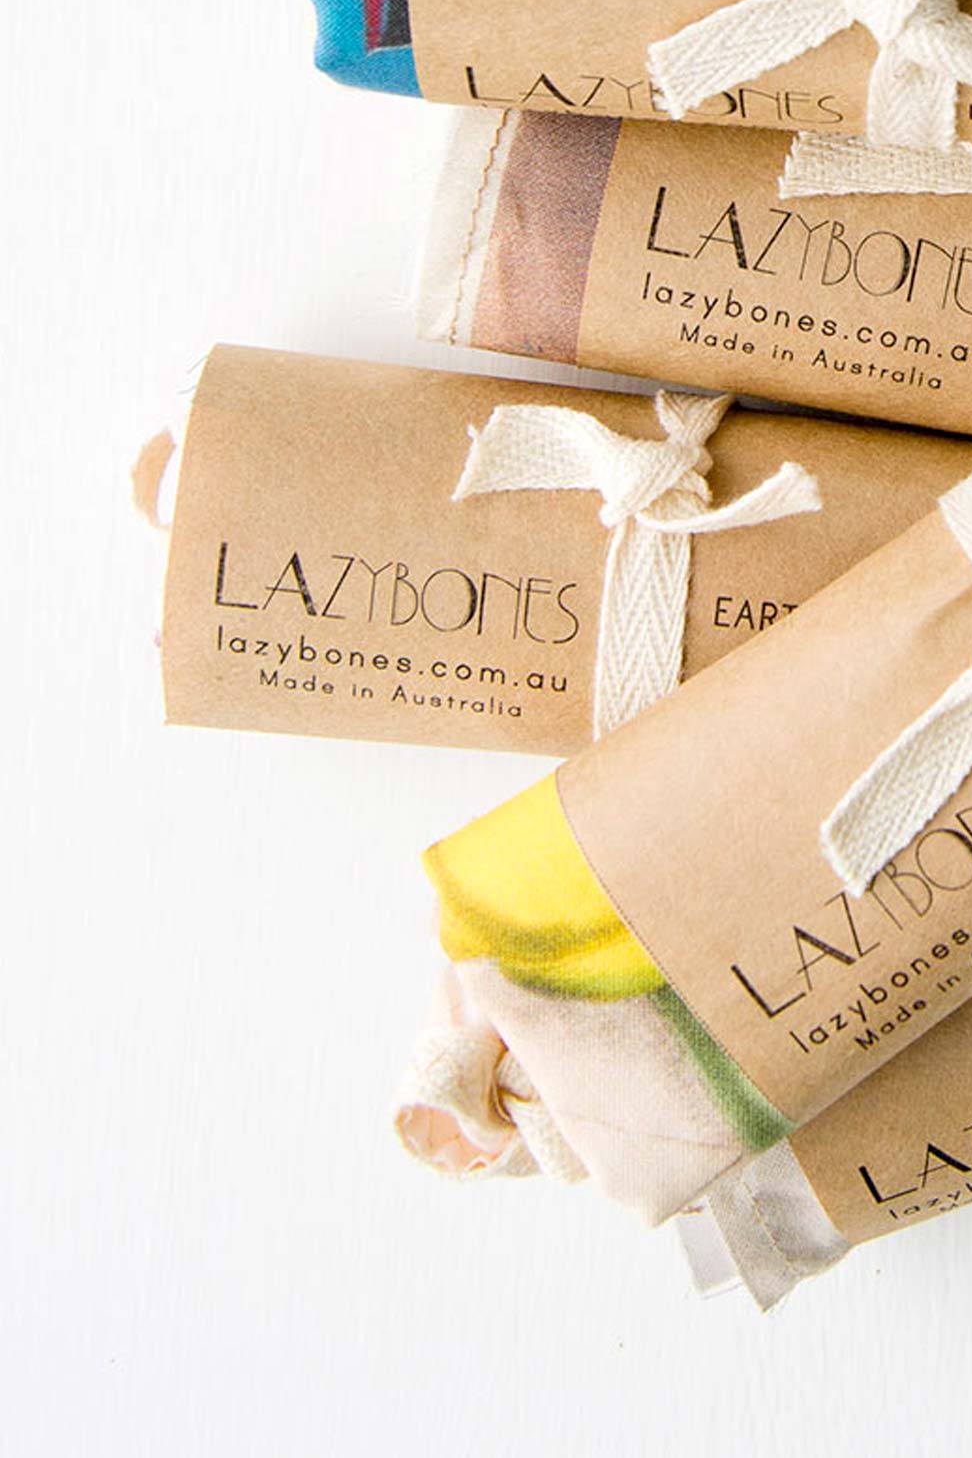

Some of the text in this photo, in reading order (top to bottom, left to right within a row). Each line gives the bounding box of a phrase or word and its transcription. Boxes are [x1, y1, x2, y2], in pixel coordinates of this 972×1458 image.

[679, 322, 942, 391] Made in Australia
[215, 542, 580, 645] LAZYBONES
[217, 625, 568, 693] lazybones.com.au
[259, 669, 522, 718] Made in Australia
[854, 998, 927, 1050] Made
[936, 976, 962, 993] in
